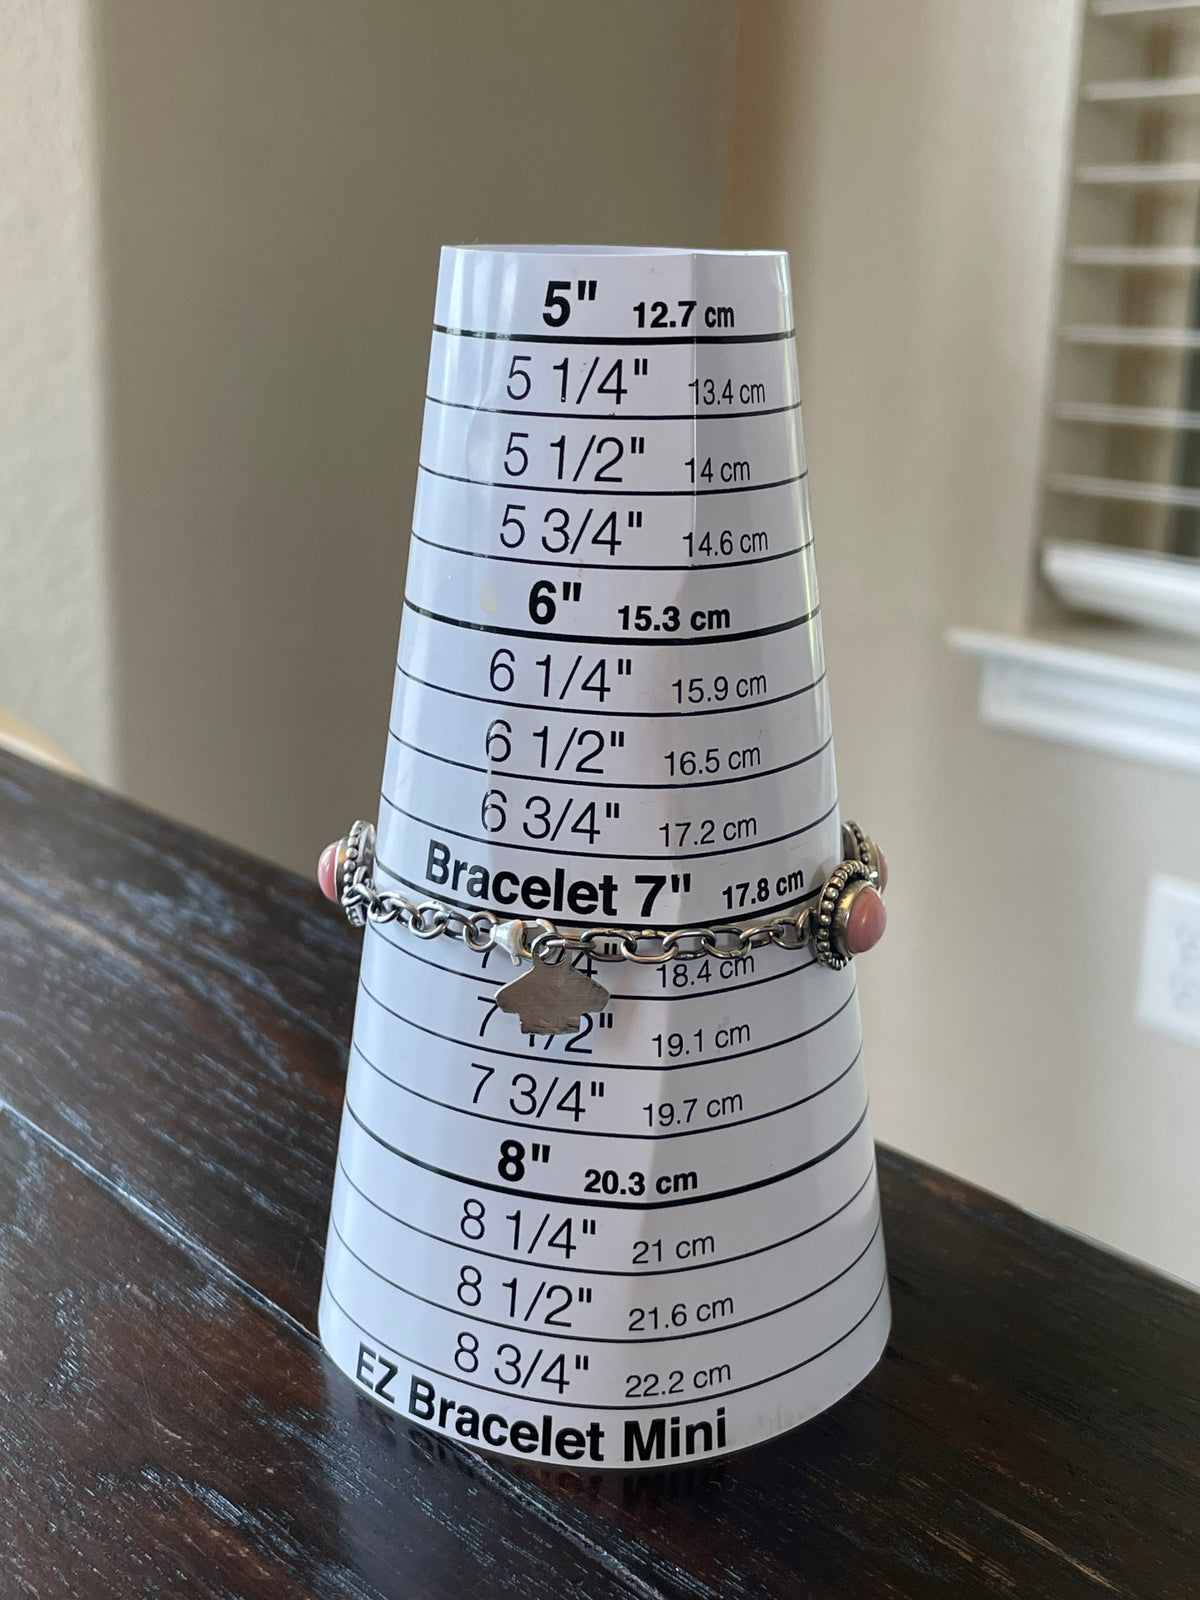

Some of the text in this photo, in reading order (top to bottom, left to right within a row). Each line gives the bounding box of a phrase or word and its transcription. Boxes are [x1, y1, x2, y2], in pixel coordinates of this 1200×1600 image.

[542, 280, 735, 328] 5" 12.7 cm
[506, 356, 766, 405] 5 1/4" 13.4 cm
[504, 432, 751, 484] 5 1/2" 14 cm
[499, 504, 768, 557] 5 3/4" 14.6 cm
[528, 580, 731, 632] 6" 15.3 cm
[489, 648, 767, 704] 6 1/4" 15.9 cm
[485, 720, 761, 777] 6 1/2" 16.5 cm
[481, 789, 757, 848] 6 3/4" 17.2 cm
[425, 839, 804, 917] Bracelet 7" 17.8 cm
[656, 960, 711, 988] 18.4
[720, 955, 754, 979] cm
[478, 996, 499, 1037] 7
[652, 1029, 703, 1058] 19.1
[715, 1023, 750, 1049] cm
[471, 1062, 743, 1127] 7 3/4" 19.7 cm
[498, 1139, 698, 1197] 8" 20.3 cm
[460, 1198, 715, 1264] 8 1/4" 21 cm
[456, 1265, 734, 1332] 8 1/2" 21.6 cm
[454, 1331, 731, 1398] 8 3/4" 22.2 cm
[356, 1341, 727, 1462] EZ Bracelet Mini
